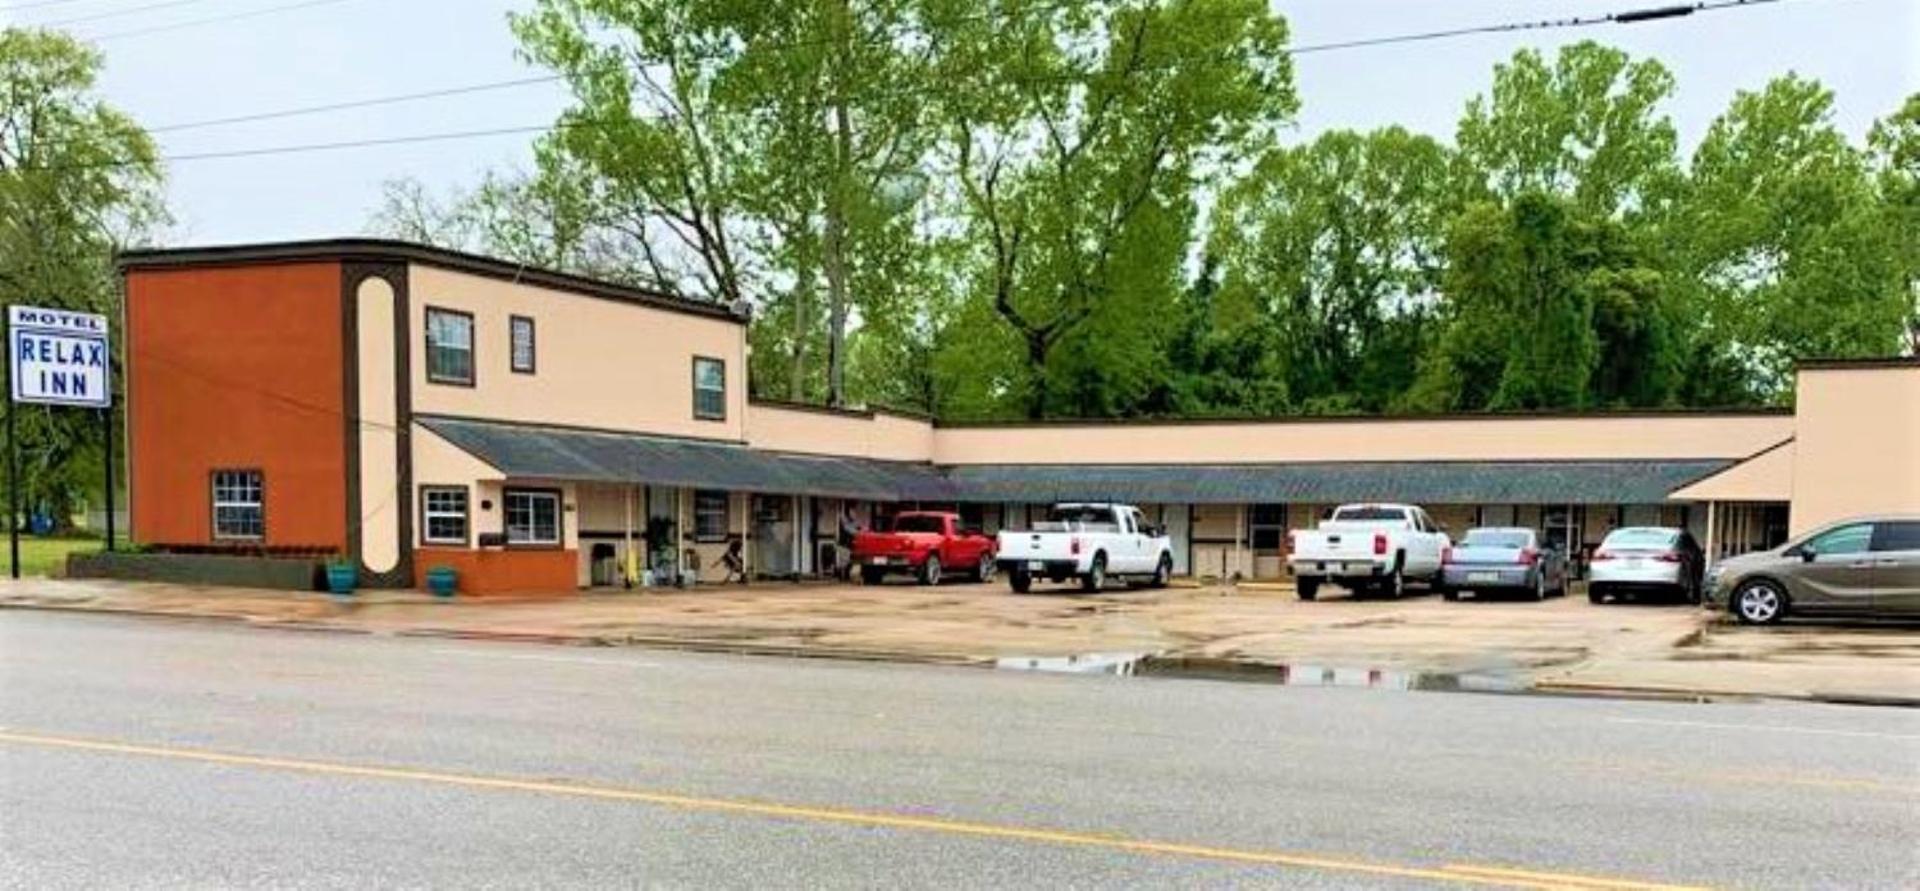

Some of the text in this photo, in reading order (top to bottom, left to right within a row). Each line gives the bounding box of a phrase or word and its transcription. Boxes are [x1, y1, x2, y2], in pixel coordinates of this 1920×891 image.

[19, 312, 101, 329] MOTEL
[22, 338, 102, 367] RELAX
[41, 370, 86, 396] INN
